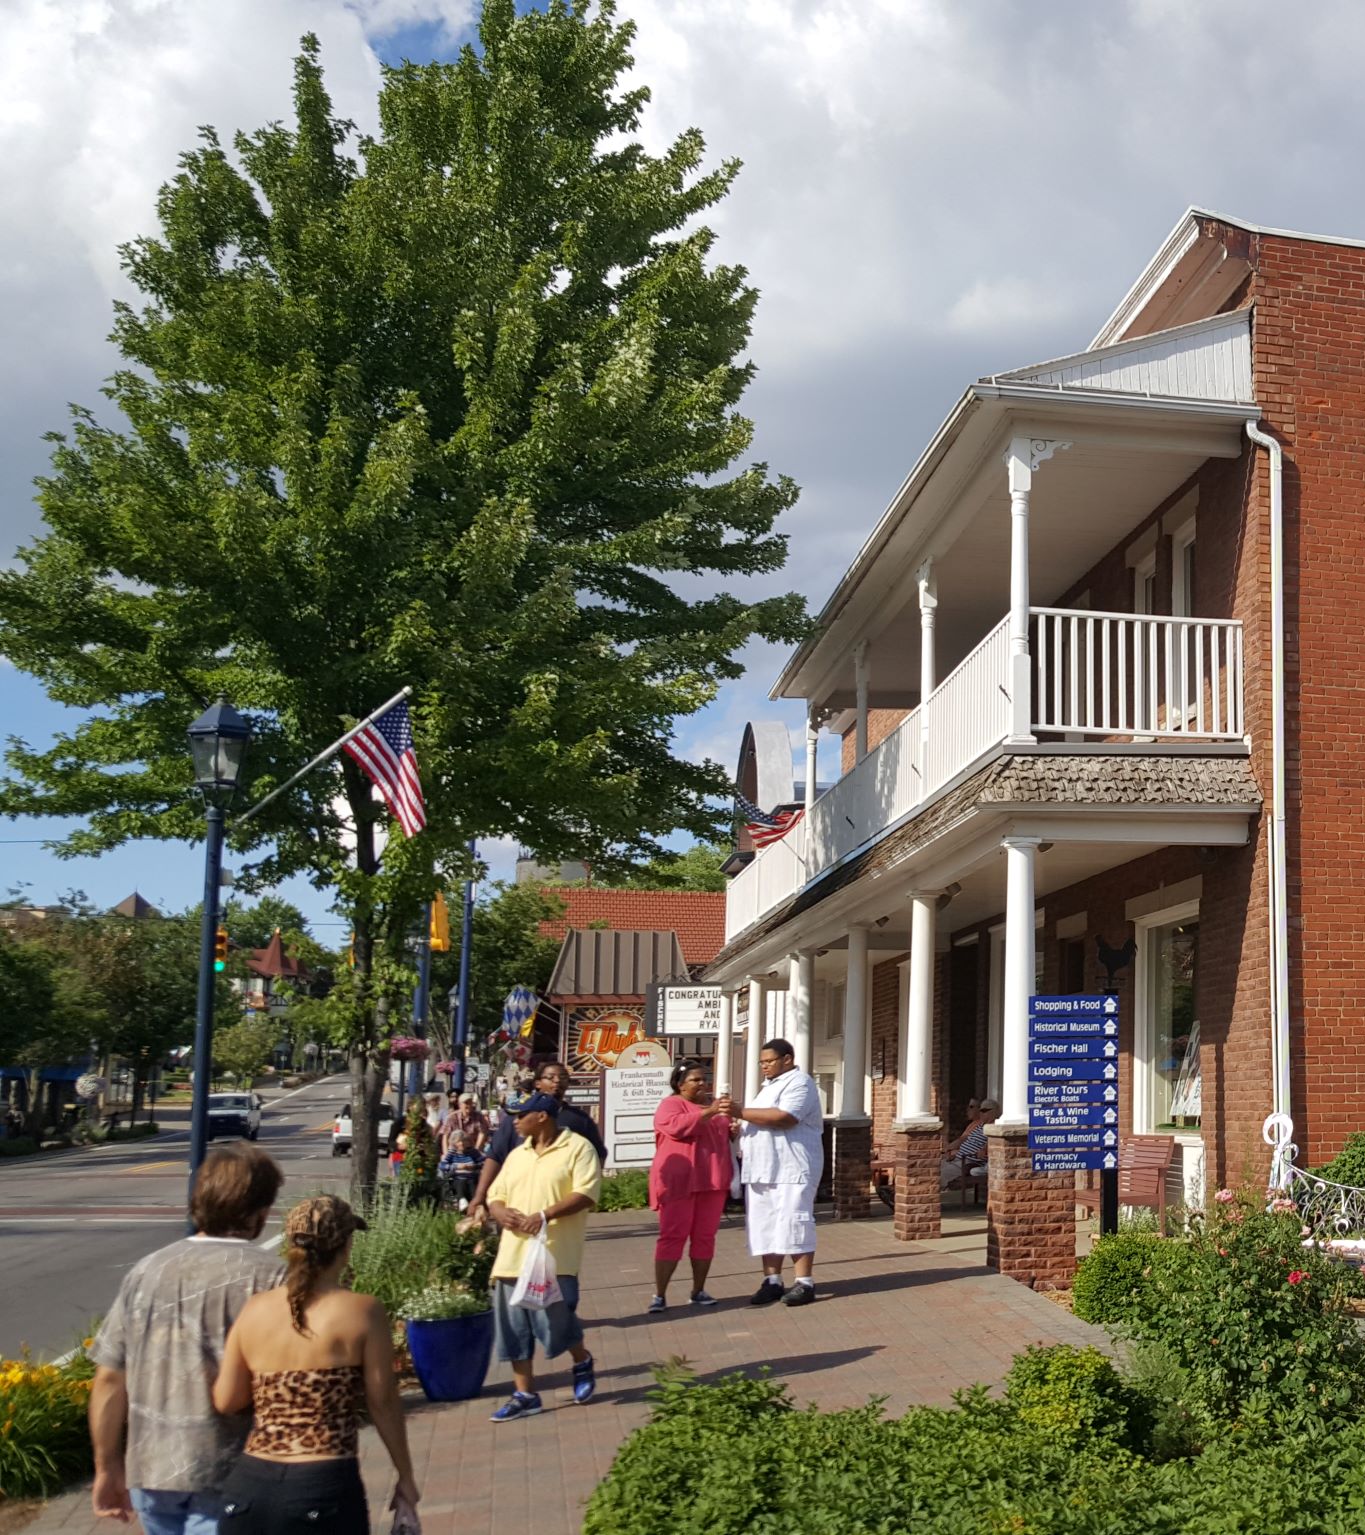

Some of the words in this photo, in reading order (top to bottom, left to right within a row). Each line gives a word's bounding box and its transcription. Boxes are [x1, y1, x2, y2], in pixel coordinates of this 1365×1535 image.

[697, 1000, 721, 1009] AMB
[1035, 1001, 1072, 1011] Shopping
[1073, 1001, 1079, 1009] &
[1080, 1000, 1100, 1009] Food
[699, 1020, 720, 1029] RYA
[1034, 1023, 1068, 1031] Historical
[1070, 1023, 1100, 1031] Museum
[1034, 1044, 1068, 1053] Fischer
[1071, 1044, 1088, 1053] Hall
[620, 1071, 664, 1079] Frankenmuth
[1033, 1067, 1072, 1076] Lodging
[646, 1088, 663, 1096] Shop
[1034, 1086, 1059, 1095] River
[1061, 1085, 1088, 1094] Tours
[1033, 1108, 1054, 1117] Beer
[1058, 1108, 1064, 1116] &
[1066, 1107, 1089, 1115] Wine
[1045, 1116, 1078, 1124] Tasting
[1034, 1135, 1065, 1144] Veterans
[1067, 1133, 1099, 1143] Memorial
[1035, 1153, 1078, 1161] Pharmacy
[1044, 1161, 1087, 1170] Hardware
